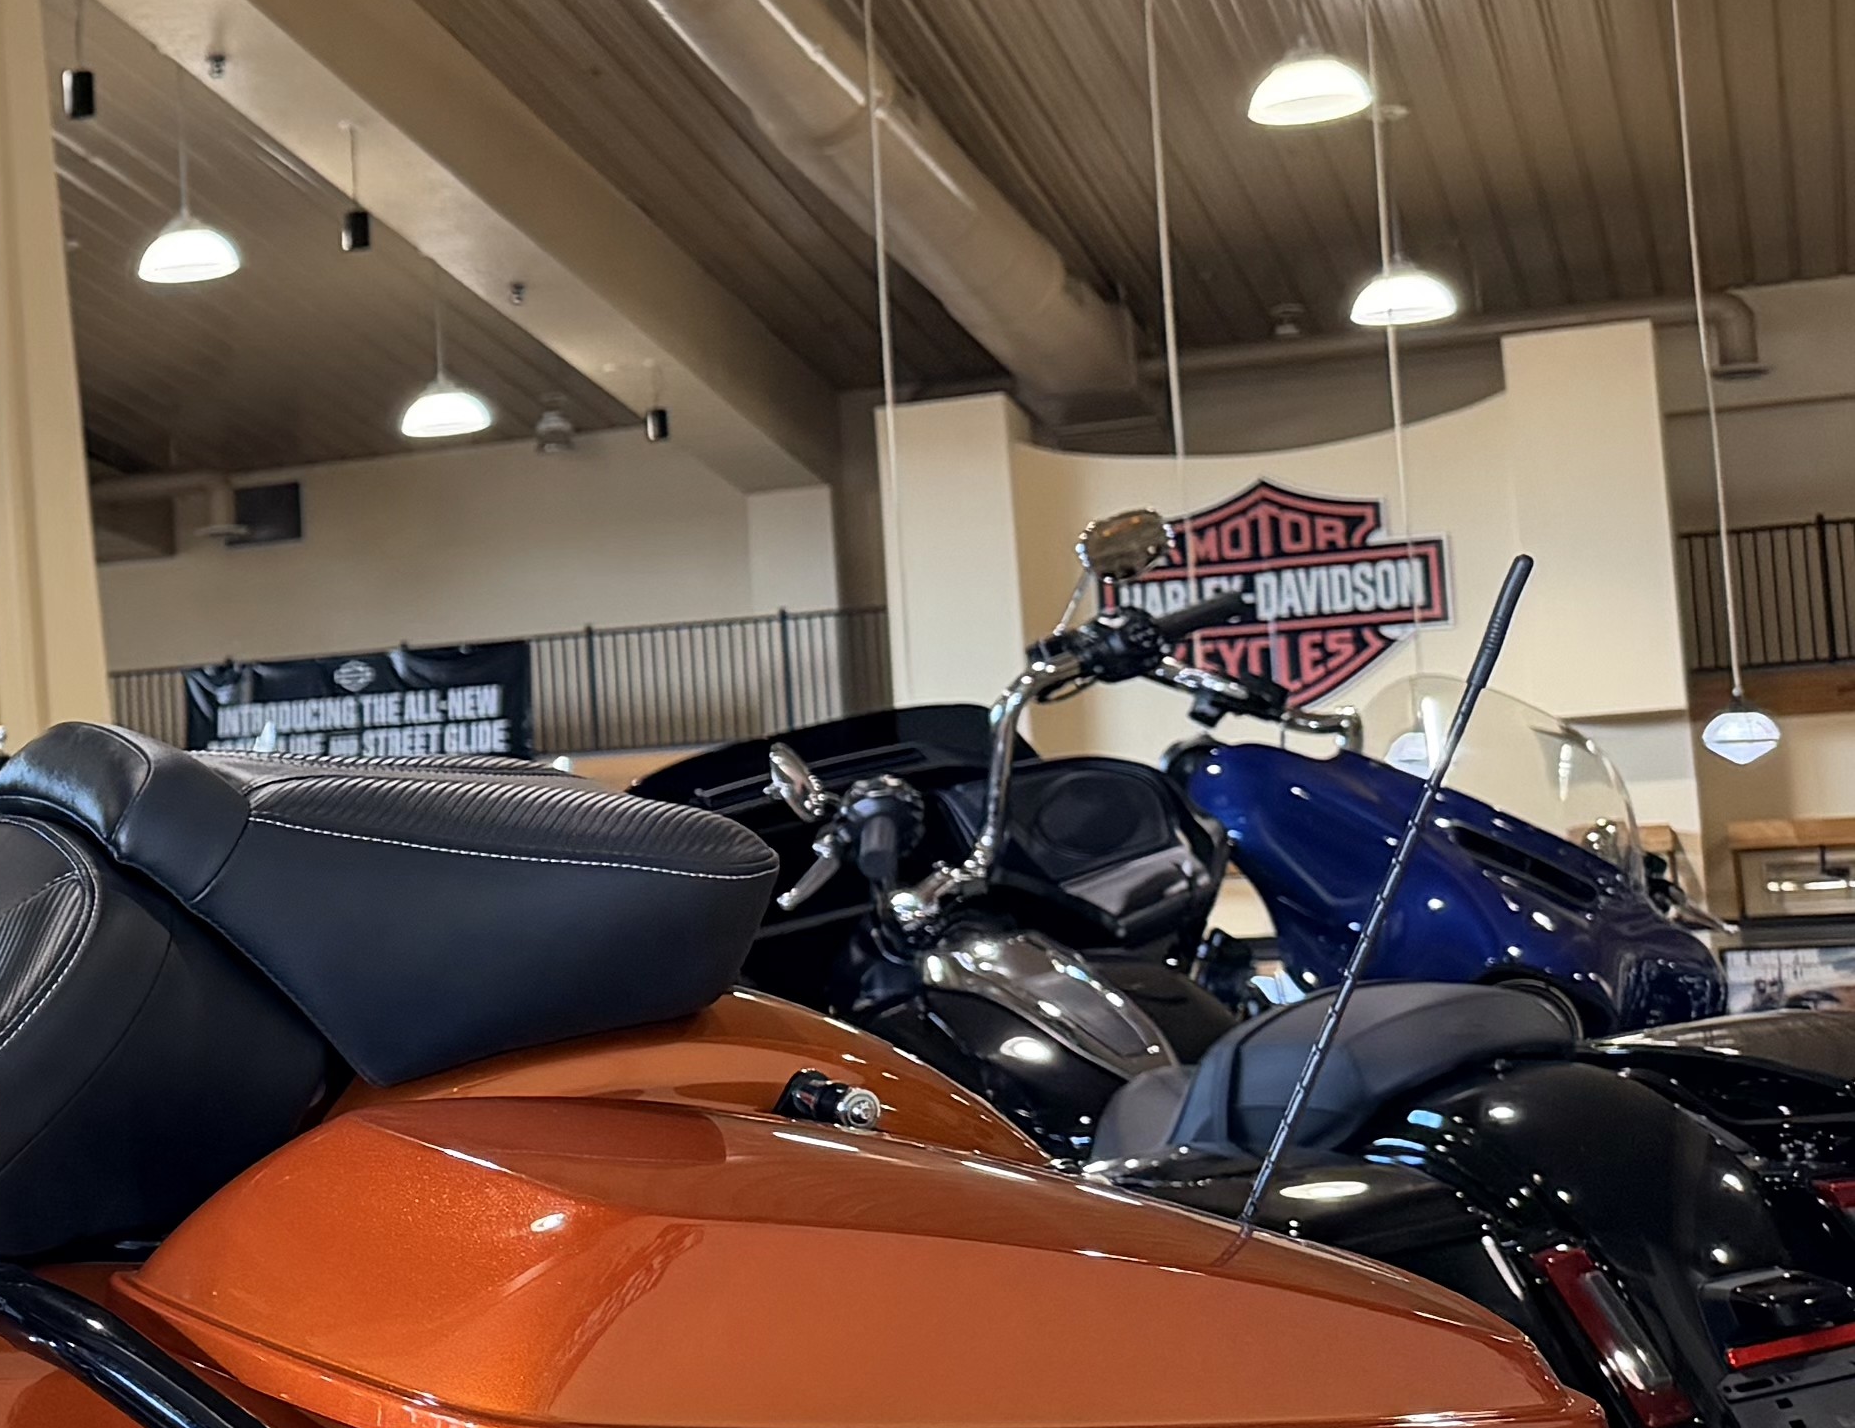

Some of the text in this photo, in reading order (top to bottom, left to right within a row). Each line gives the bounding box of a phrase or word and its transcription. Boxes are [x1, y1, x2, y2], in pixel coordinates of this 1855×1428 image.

[1190, 501, 1348, 563] MOTOR
[217, 684, 501, 737] INTRODUCING THE ALL-NEW
[363, 723, 439, 757] STREET
[444, 719, 510, 754] GLIDE
